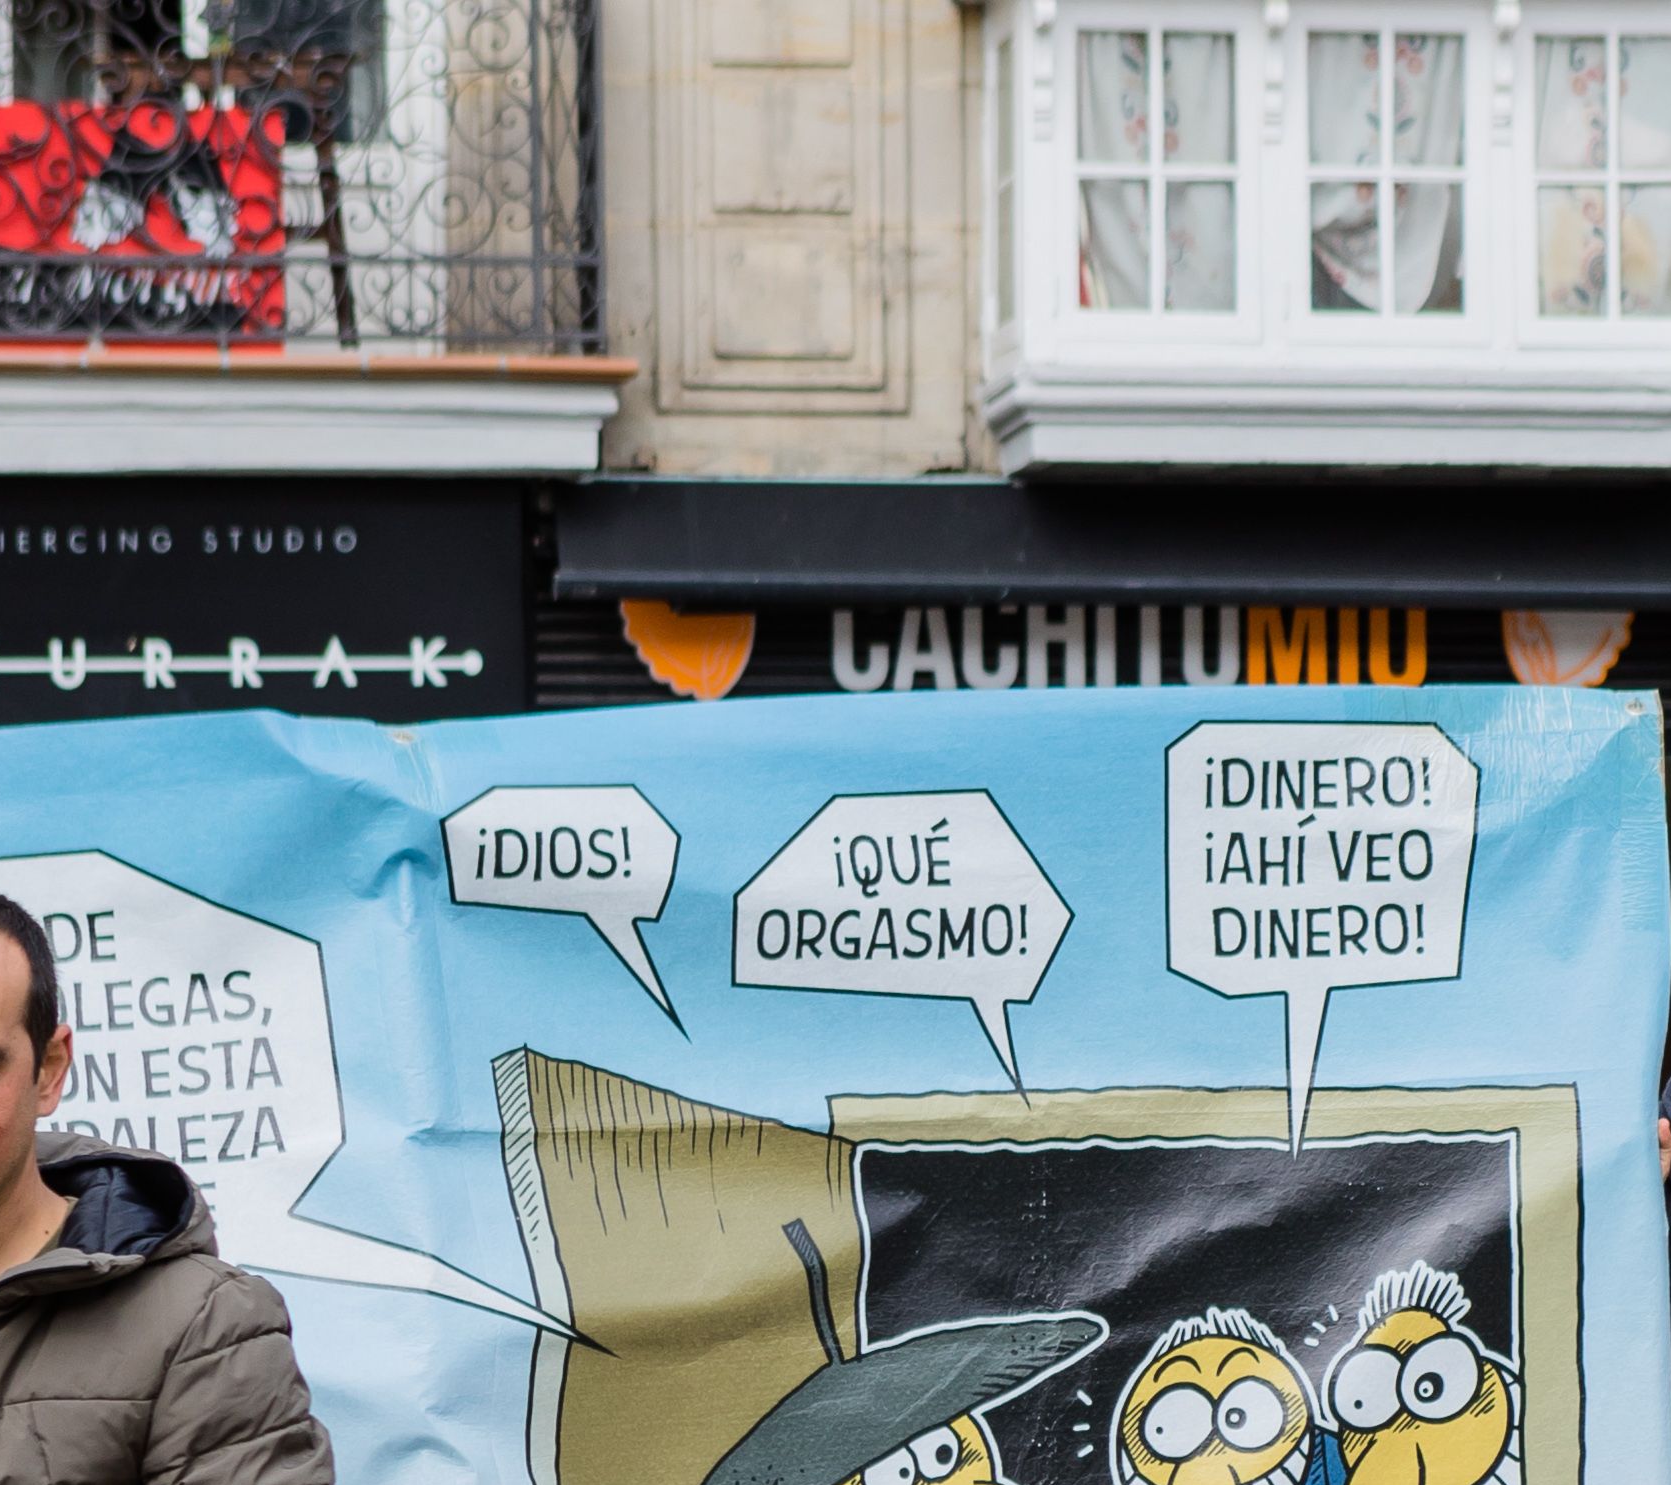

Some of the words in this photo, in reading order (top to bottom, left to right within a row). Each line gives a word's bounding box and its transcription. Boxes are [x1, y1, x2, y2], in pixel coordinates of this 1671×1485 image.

[202, 526, 359, 555] STUDIO
[1205, 756, 1433, 810] ¡DINERO!
[475, 826, 633, 882] ¡DIOS!
[833, 818, 952, 898] ¡QUÉ
[1205, 813, 1317, 887] ¡AHÍ
[1327, 829, 1433, 882] VEO
[756, 903, 1029, 961] ORGASMO!
[1211, 903, 1425, 959] DINERO!
[141, 1036, 284, 1099] ESTA
